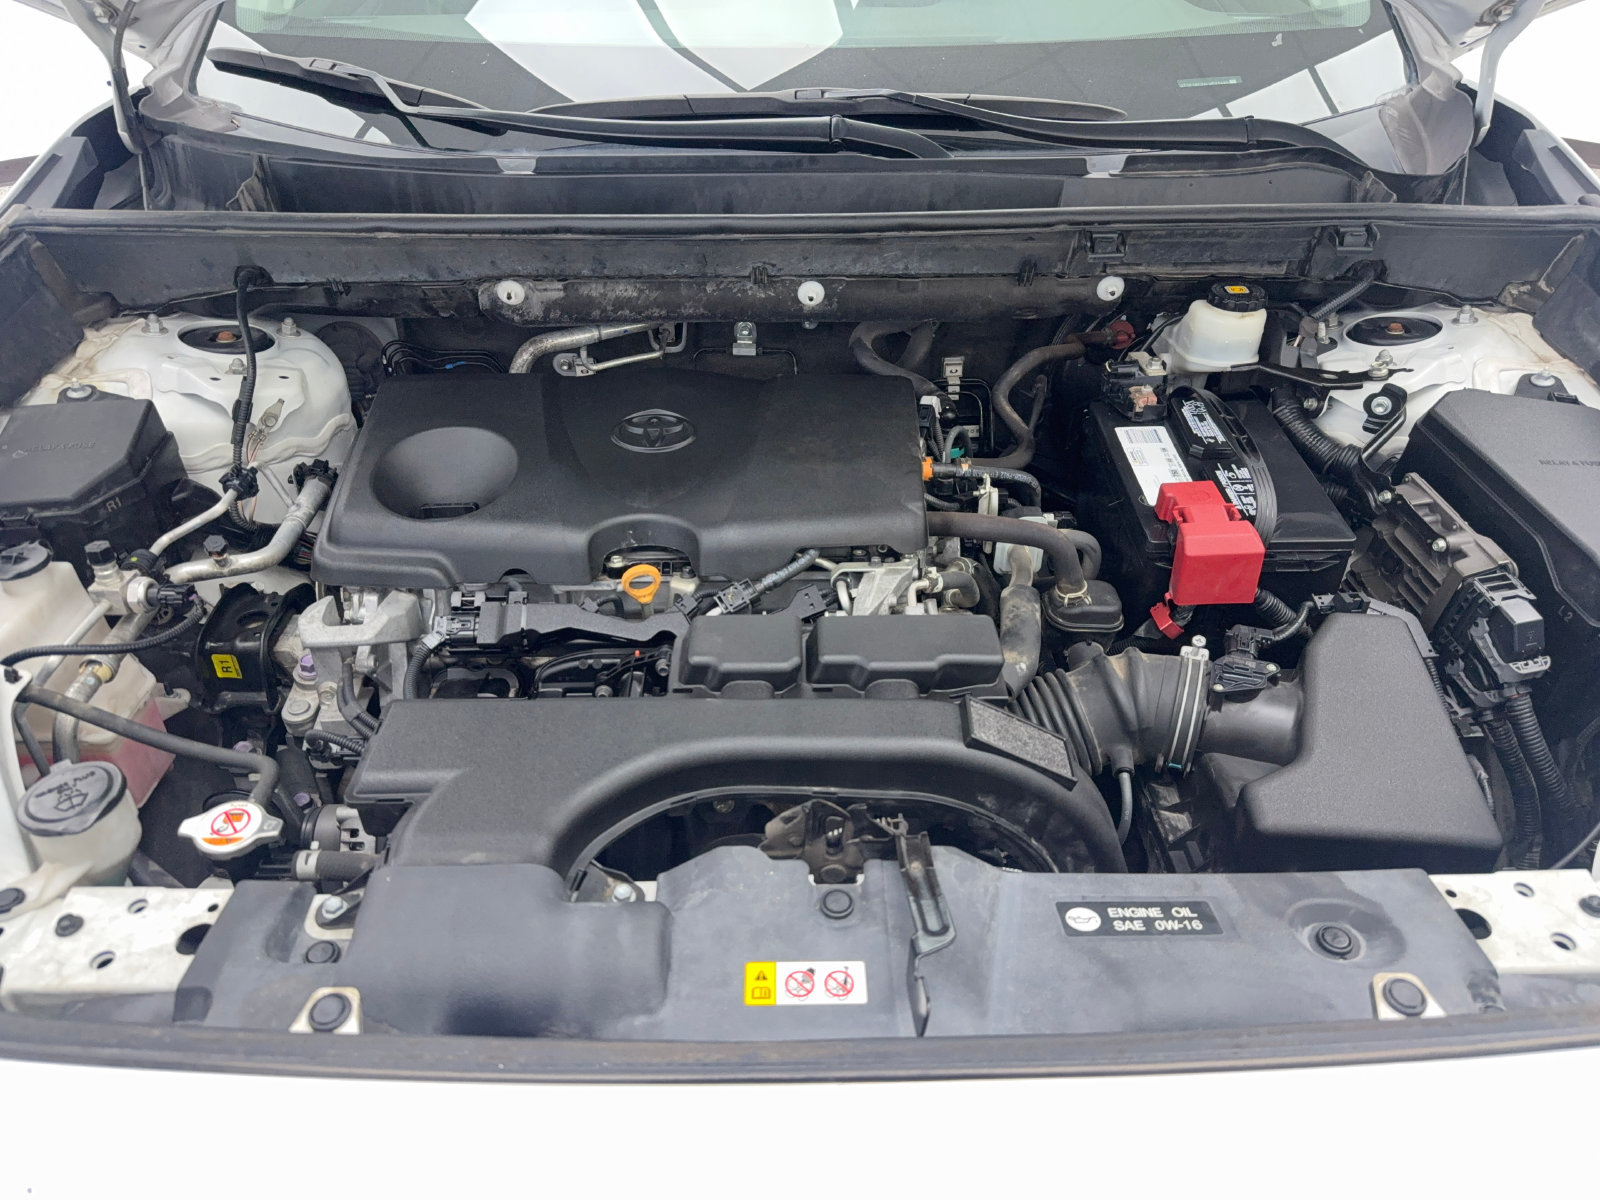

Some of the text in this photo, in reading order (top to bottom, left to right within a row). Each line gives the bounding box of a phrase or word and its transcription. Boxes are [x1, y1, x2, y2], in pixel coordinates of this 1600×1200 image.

[106, 496, 122, 512] R1
[218, 660, 232, 673] R1
[1107, 907, 1198, 918] ENGINE OIL
[1113, 919, 1203, 931] SAE 0W-16
